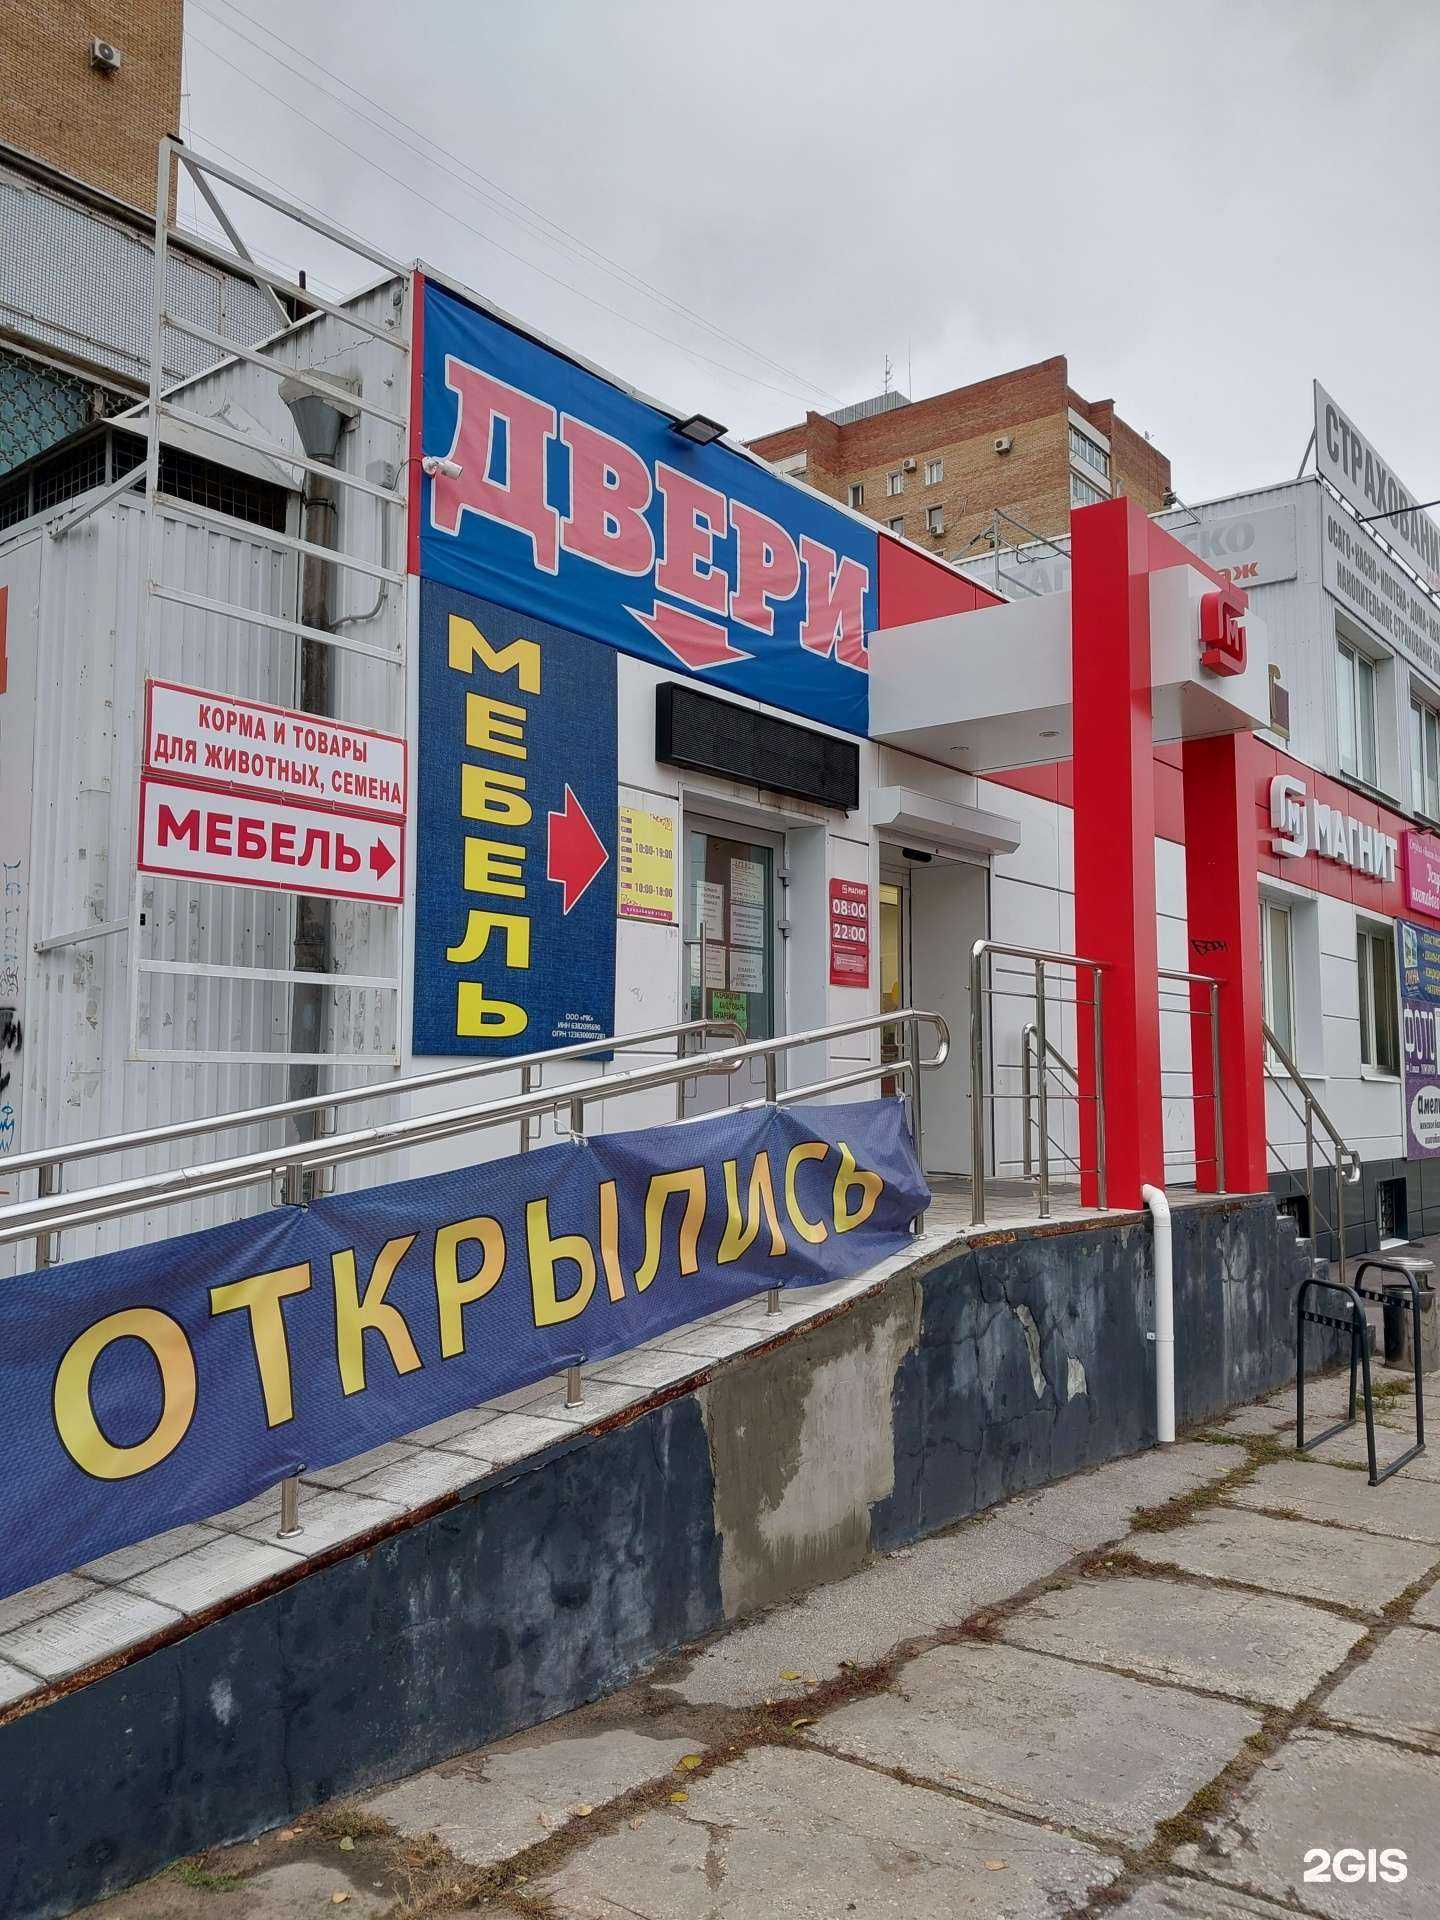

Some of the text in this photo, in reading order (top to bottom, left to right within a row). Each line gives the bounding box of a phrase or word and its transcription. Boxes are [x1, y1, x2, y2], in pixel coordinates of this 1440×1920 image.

[431, 354, 869, 674] ДВЕРИ
[1325, 403, 1440, 575] СТРАХОВАНИ
[154, 733, 402, 805] ДЛЯ ЖИВОТНЫХ, СЕМЕНА
[199, 704, 368, 763] КОРМА И ТОВАРЫ
[157, 803, 362, 873] МЕБЕЛЬ
[446, 612, 542, 1040] МЕБЕЛЬ
[1312, 798, 1398, 883] МАГНИТ
[833, 899, 866, 918] 08:00
[834, 923, 866, 942] 22:00
[1404, 1002, 1435, 1060] ФОТО
[52, 1141, 884, 1482] ОТКРЫЛИСЬ
